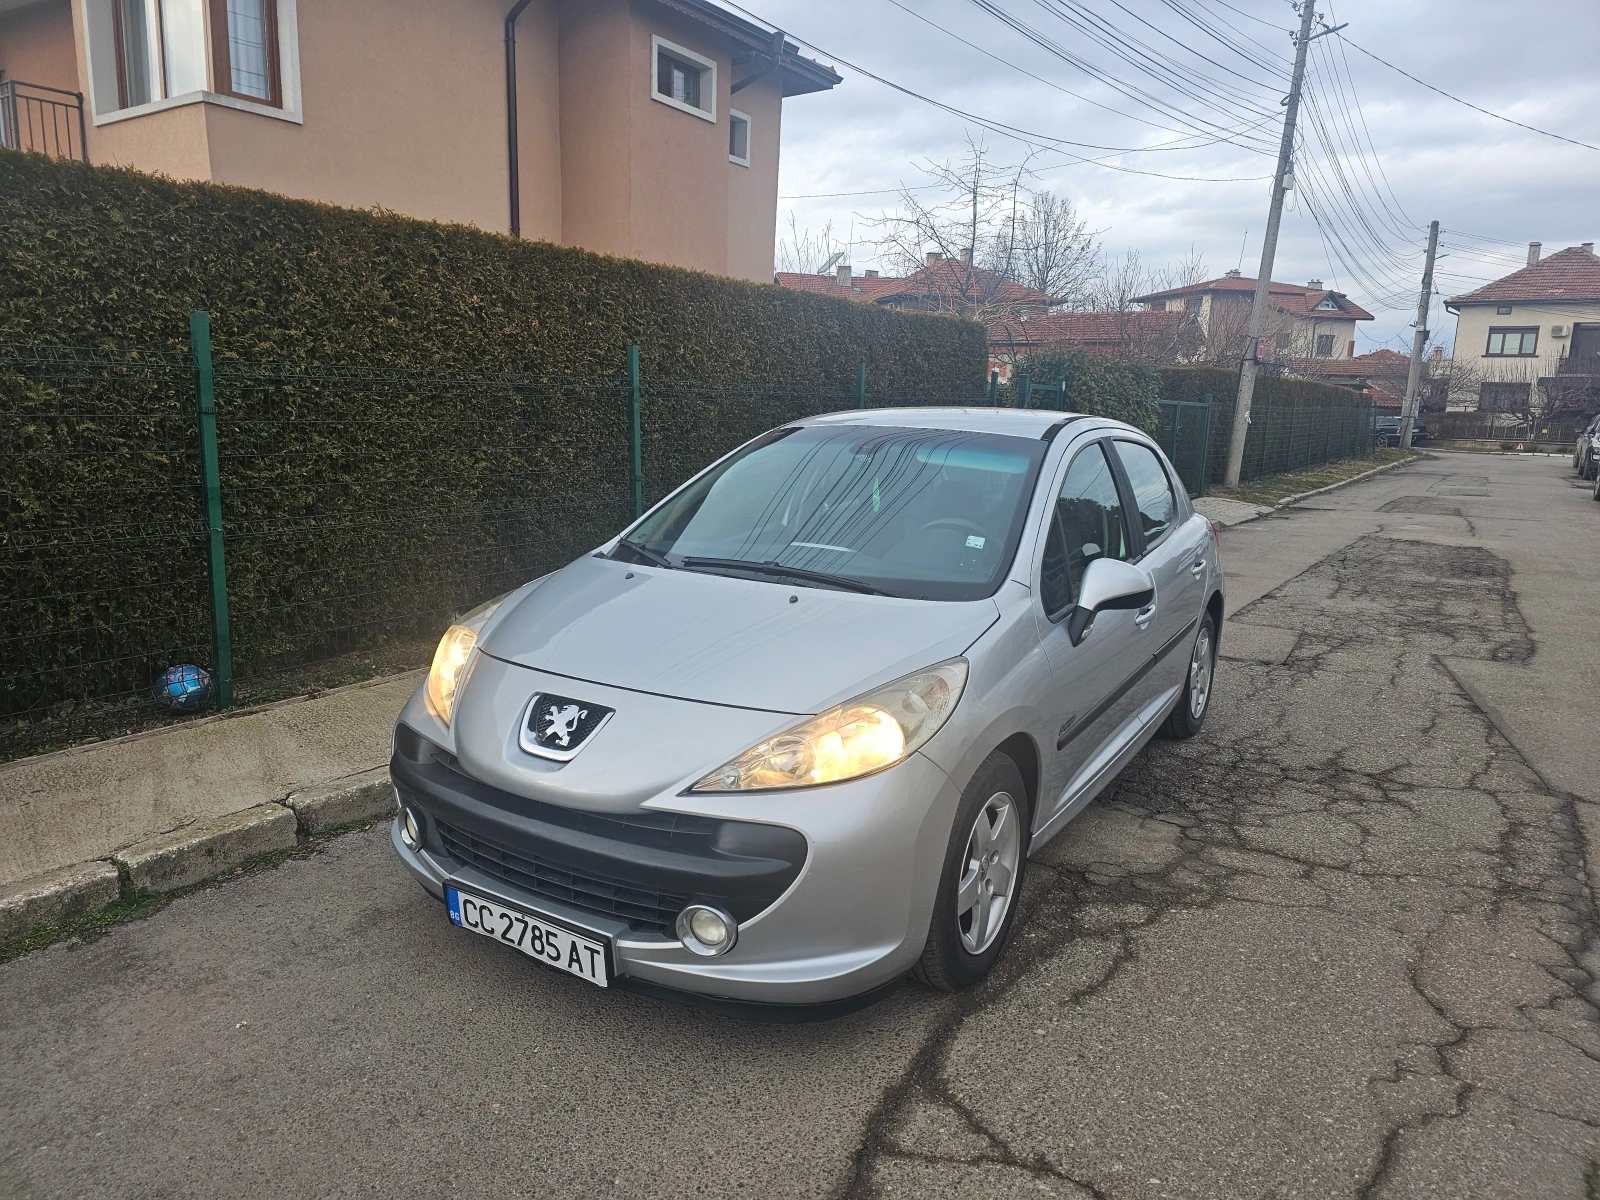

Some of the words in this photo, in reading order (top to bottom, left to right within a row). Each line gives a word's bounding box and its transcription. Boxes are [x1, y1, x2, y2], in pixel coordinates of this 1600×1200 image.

[449, 909, 460, 921] BG
[462, 898, 495, 935] CC
[499, 912, 562, 962] 2785
[567, 940, 601, 979] AT
